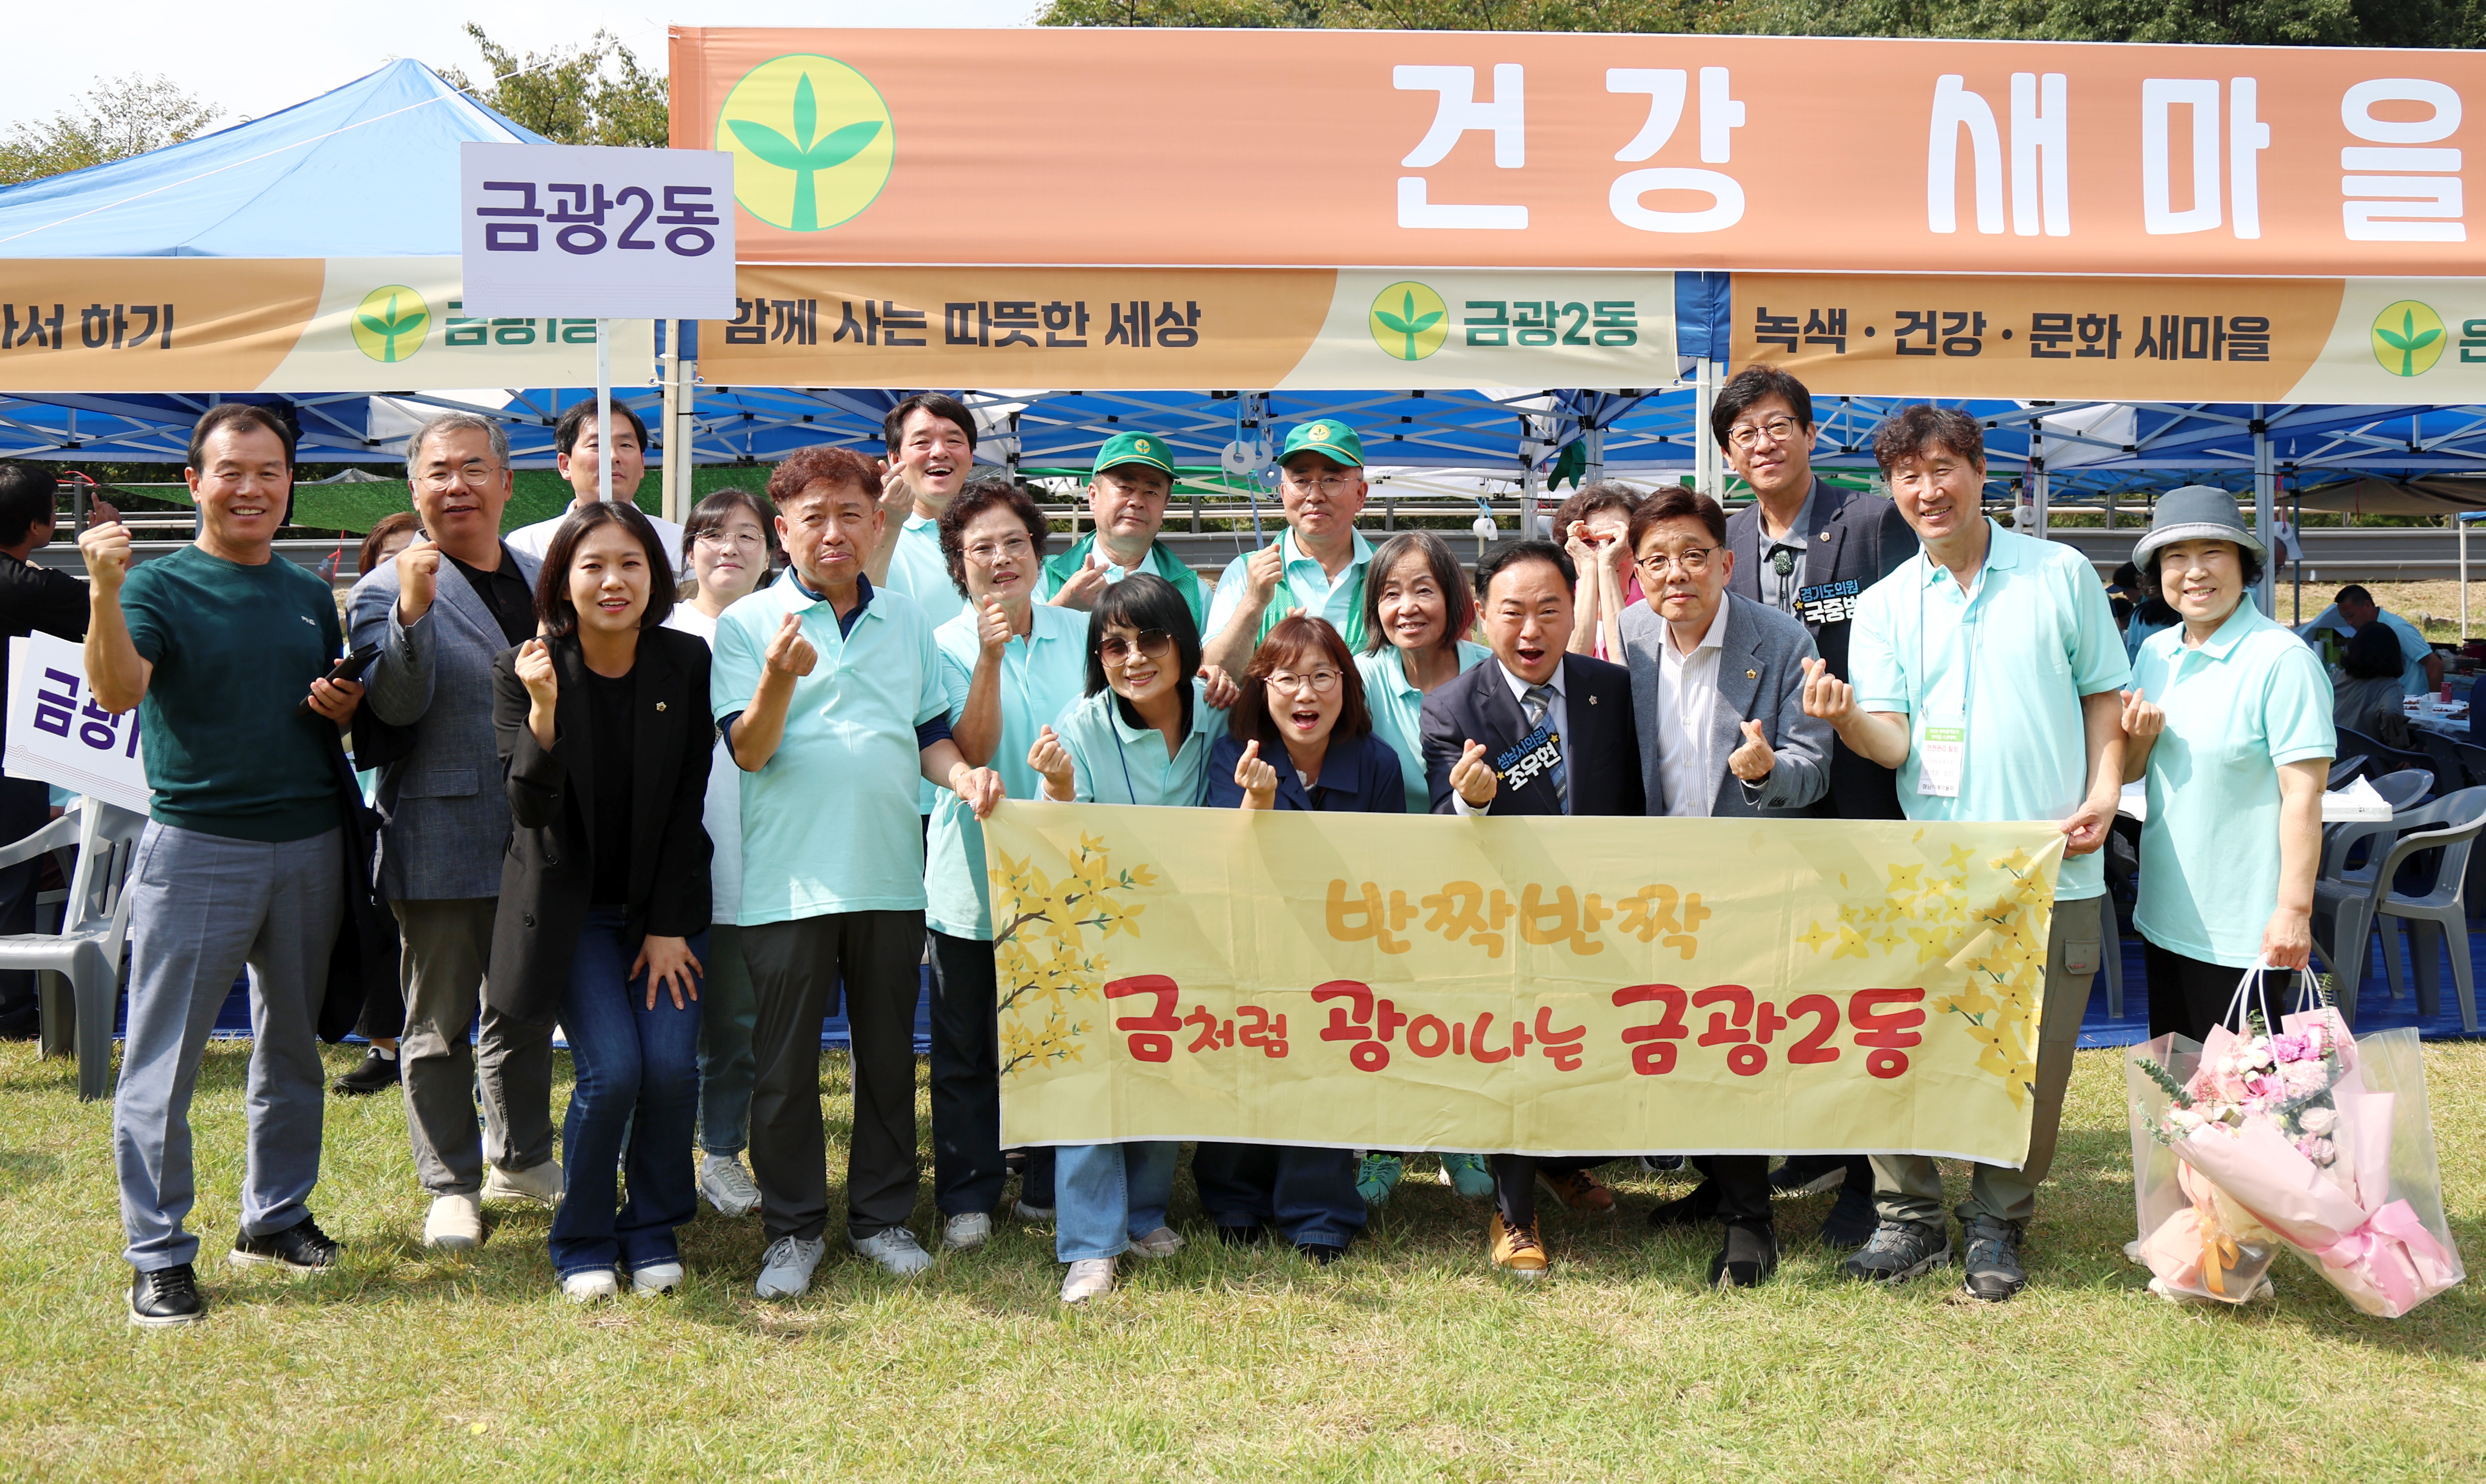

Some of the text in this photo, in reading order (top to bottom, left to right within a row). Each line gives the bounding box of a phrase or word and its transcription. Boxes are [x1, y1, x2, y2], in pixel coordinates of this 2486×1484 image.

[1393, 63, 2467, 242] 건강 새마을
[477, 181, 719, 257] 금광2동
[81, 304, 174, 349] 하기
[725, 298, 1201, 347] 함께 사는 따뜻한 세상
[1464, 301, 1638, 346] 금광2동
[1754, 307, 1847, 354] 녹색
[1894, 311, 1987, 357] 건강
[2030, 312, 2122, 359] 문화
[2134, 314, 2271, 361] 새마을
[1800, 579, 1859, 602] 경기도의원
[1496, 727, 1549, 770] 성남시의원
[1505, 740, 1561, 791] 조우현
[1326, 879, 1712, 960] 반짝반짝
[1104, 974, 1926, 1078] 금처럼 광이나는 금광2동
